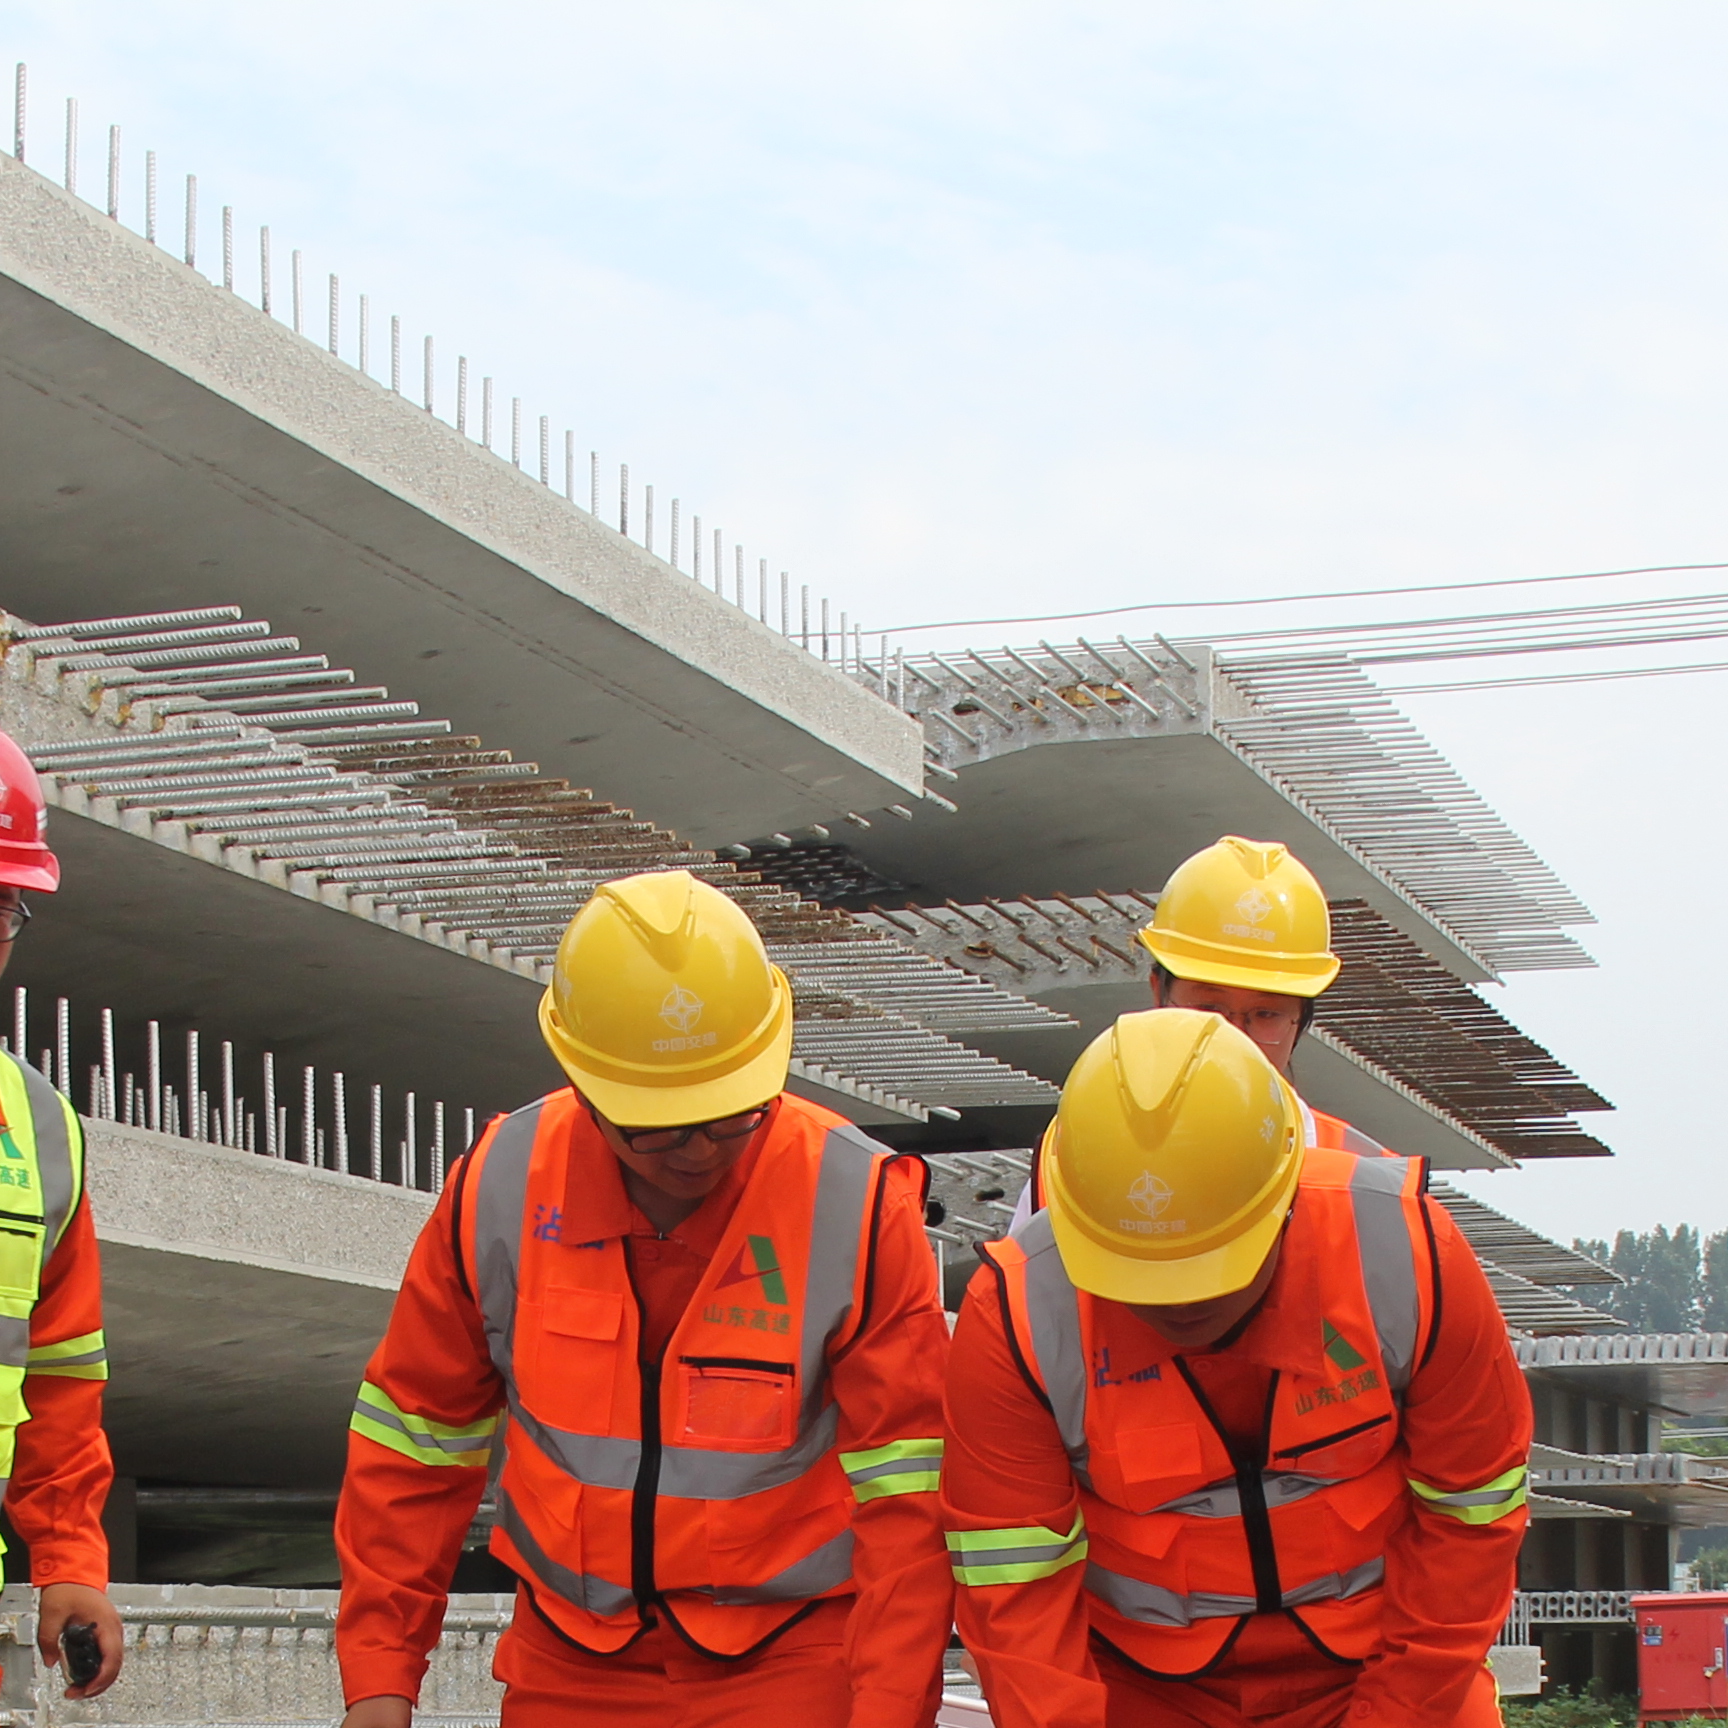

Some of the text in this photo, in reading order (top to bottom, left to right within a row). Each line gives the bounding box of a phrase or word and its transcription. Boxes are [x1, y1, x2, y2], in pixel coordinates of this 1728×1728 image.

[652, 1031, 718, 1053] 中国交建
[1118, 1218, 1187, 1235] 中国交建
[702, 1303, 792, 1336] 山东高速
[1293, 1368, 1381, 1417] 山东高速
